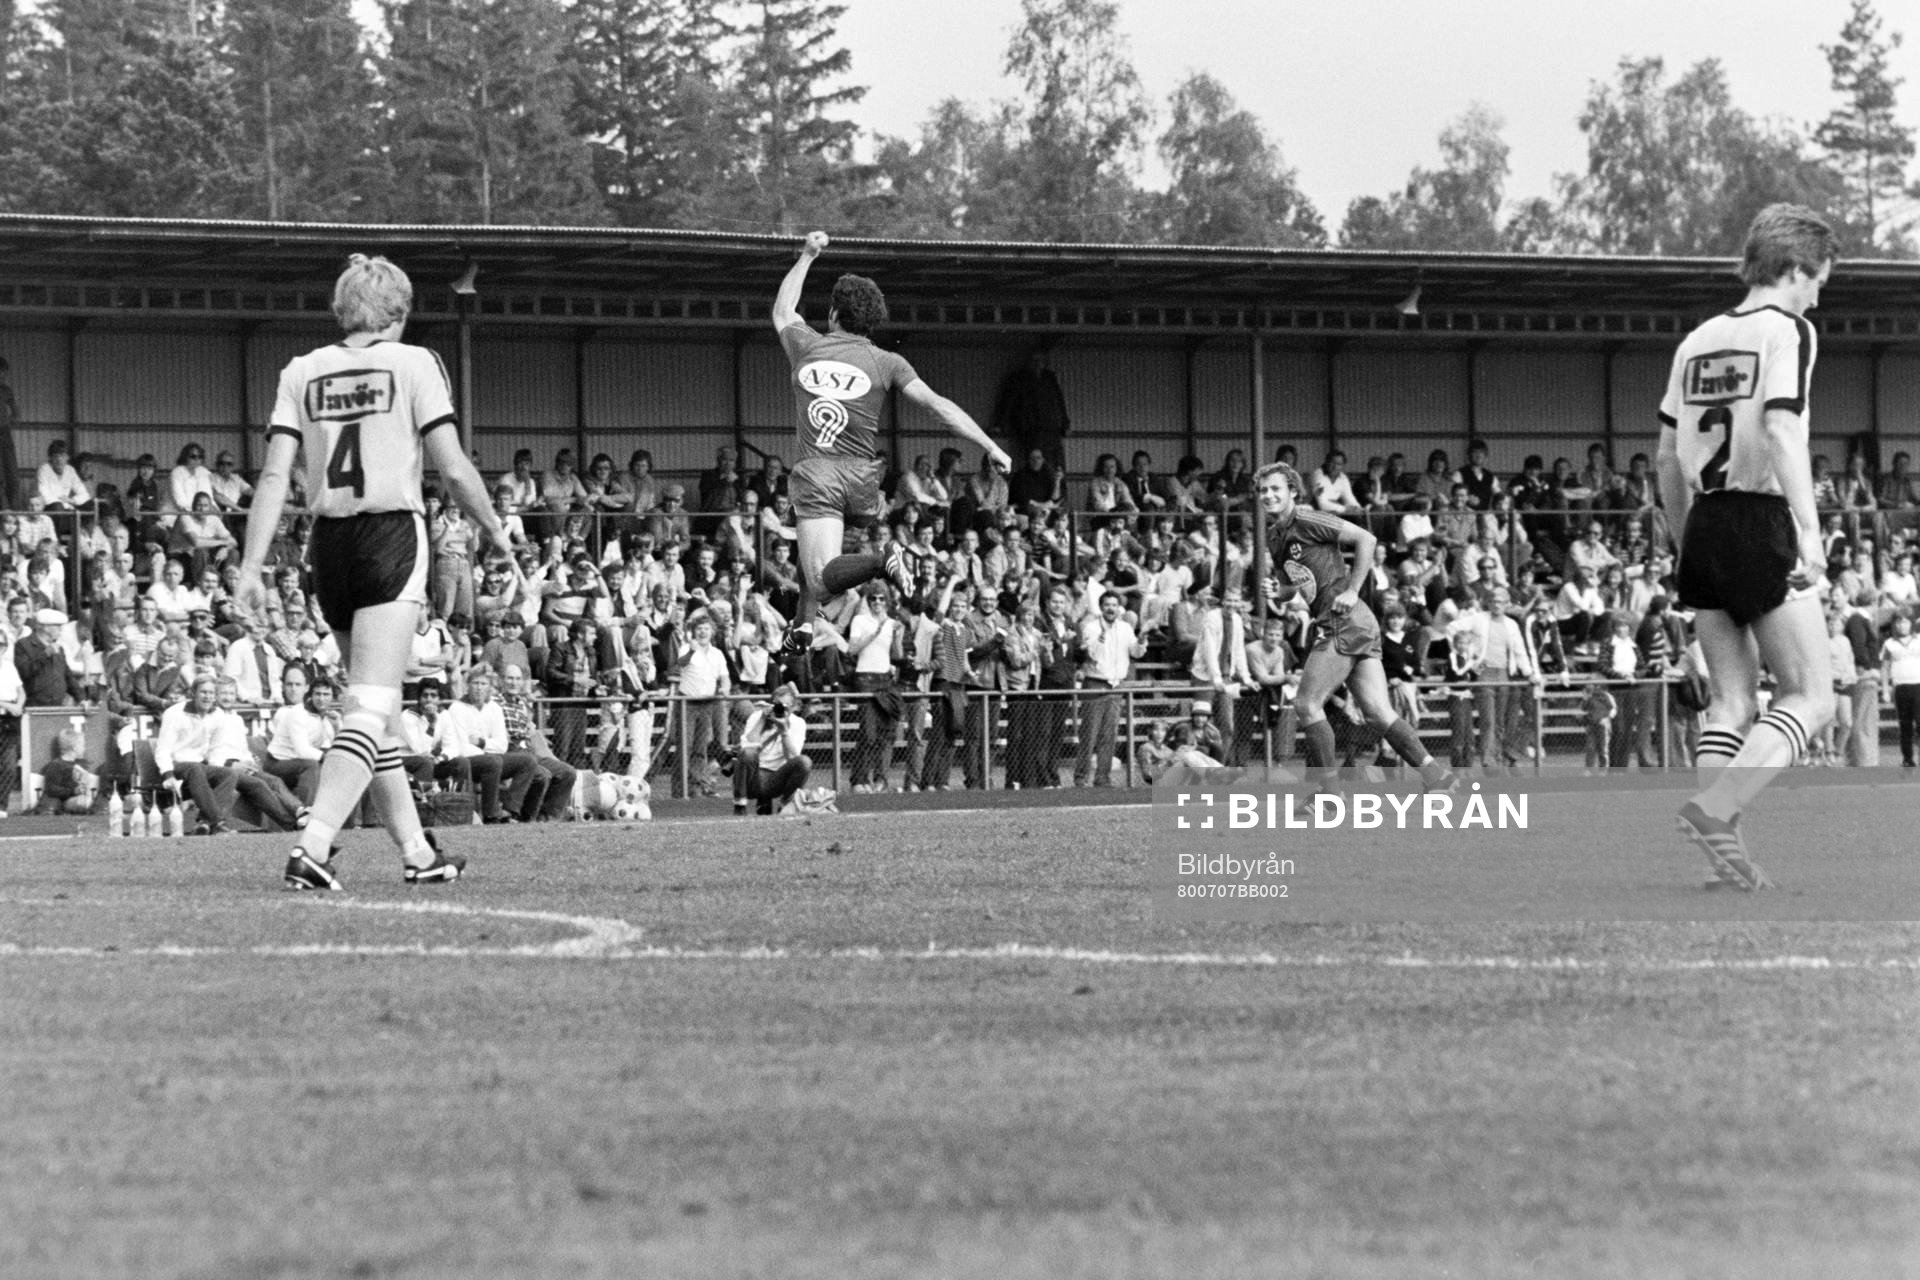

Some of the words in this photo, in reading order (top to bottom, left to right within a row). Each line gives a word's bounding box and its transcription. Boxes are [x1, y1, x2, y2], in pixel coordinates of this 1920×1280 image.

[317, 379, 384, 411] favör
[807, 397, 848, 447] 9
[327, 423, 365, 498] 4
[1698, 407, 1733, 489] 2
